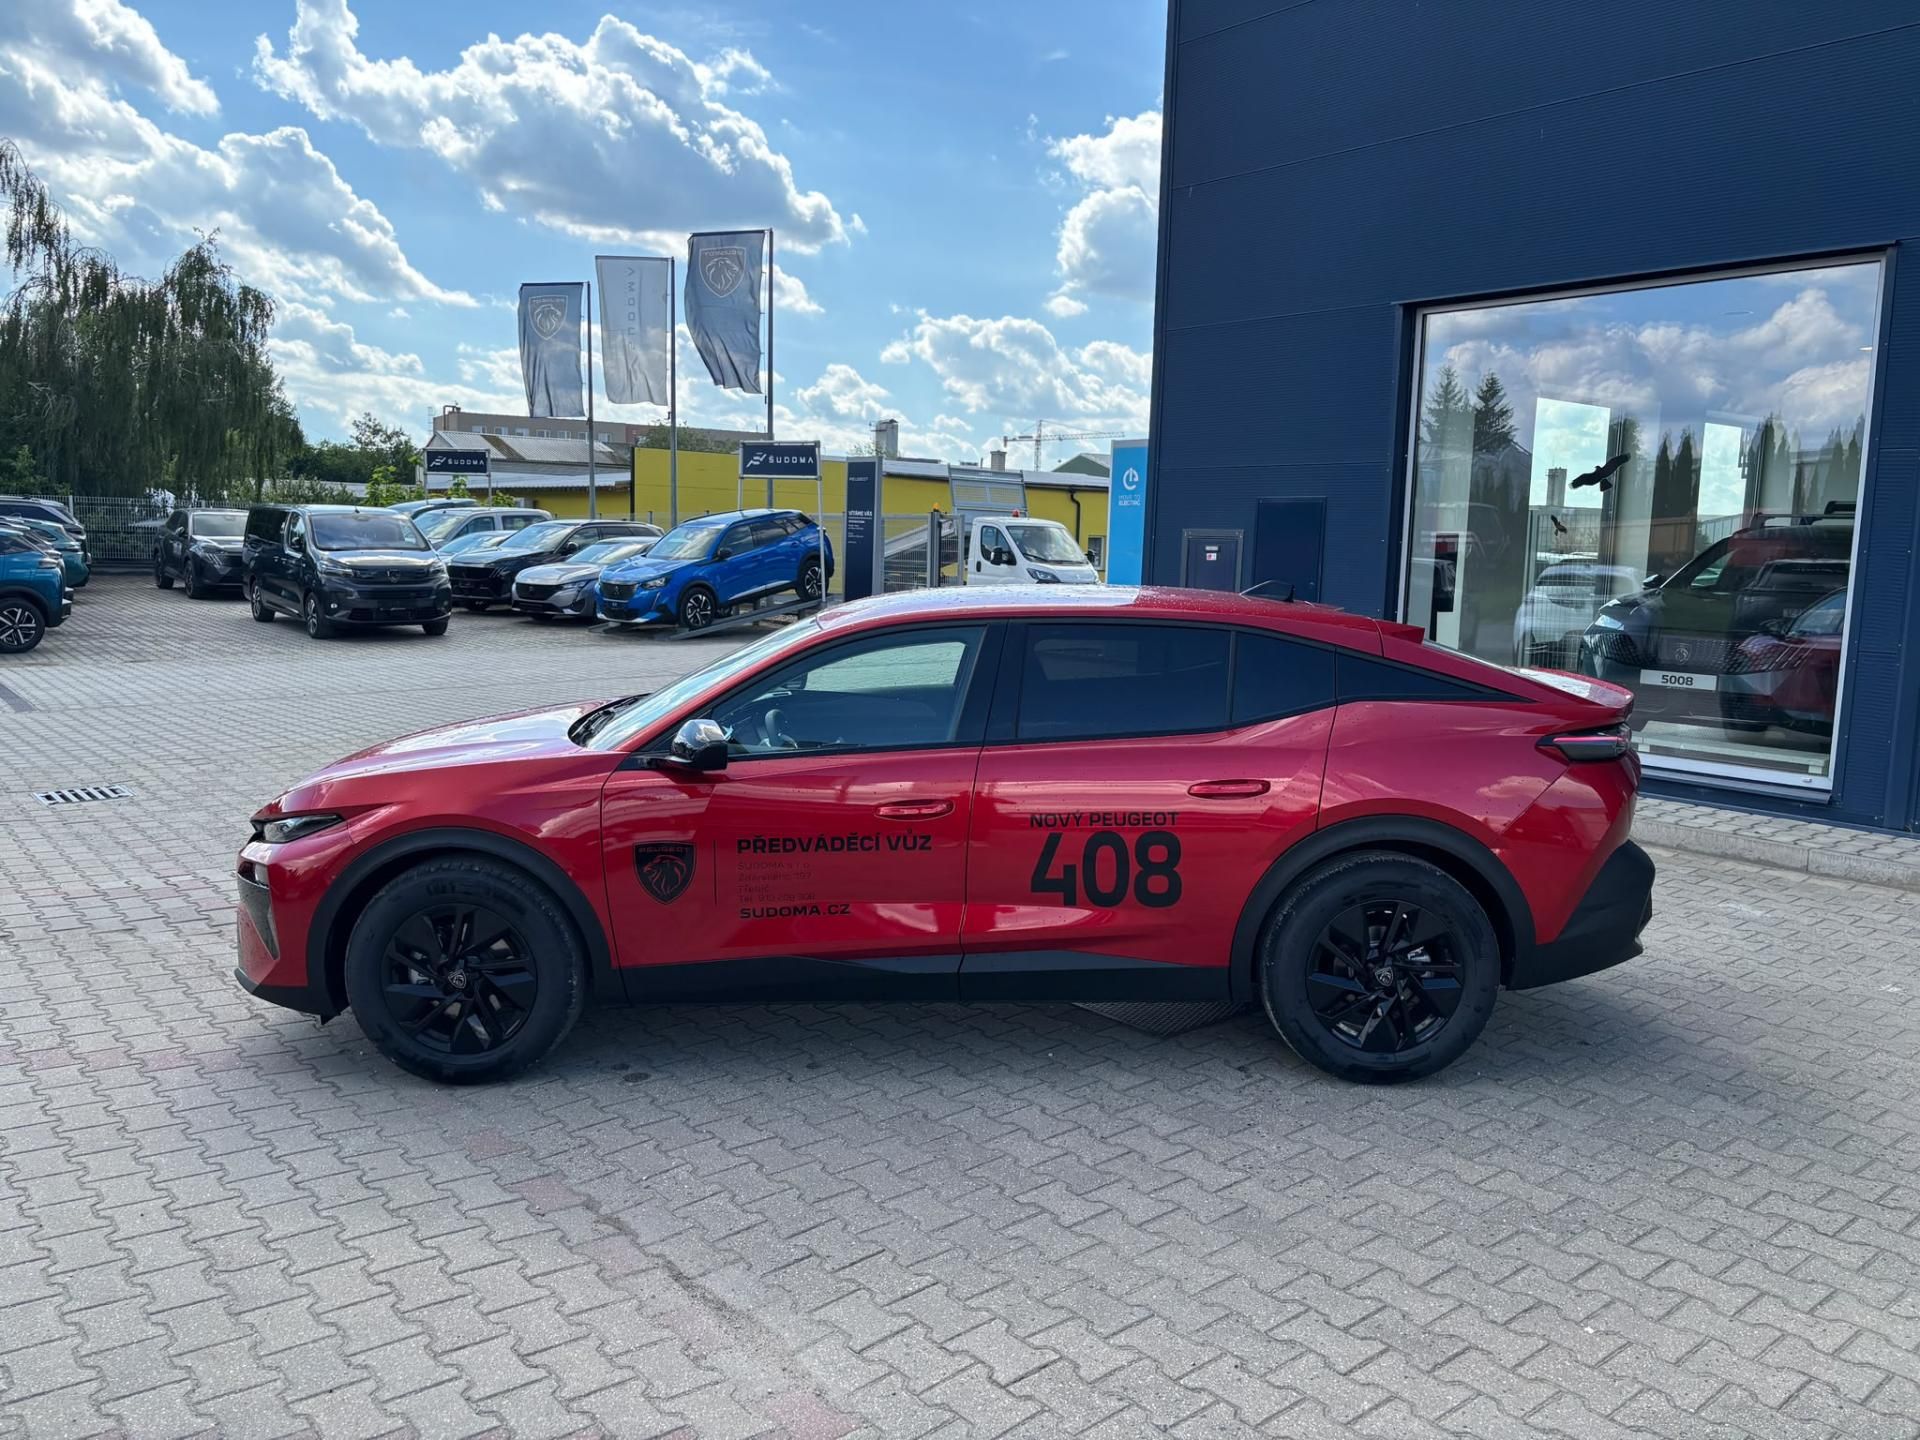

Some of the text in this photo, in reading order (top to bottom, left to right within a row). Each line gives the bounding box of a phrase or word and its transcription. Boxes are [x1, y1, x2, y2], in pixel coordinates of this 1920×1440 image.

[768, 454, 813, 464] ŠUDOMA
[1661, 674, 1694, 686] 5008
[1030, 810, 1179, 828] NOVÝ PEUGEOT
[737, 828, 932, 854] PŘEDVÁDĚCÍ VŮZ
[1030, 830, 1182, 908] 408
[740, 904, 850, 919] SUDOMA.CZ
